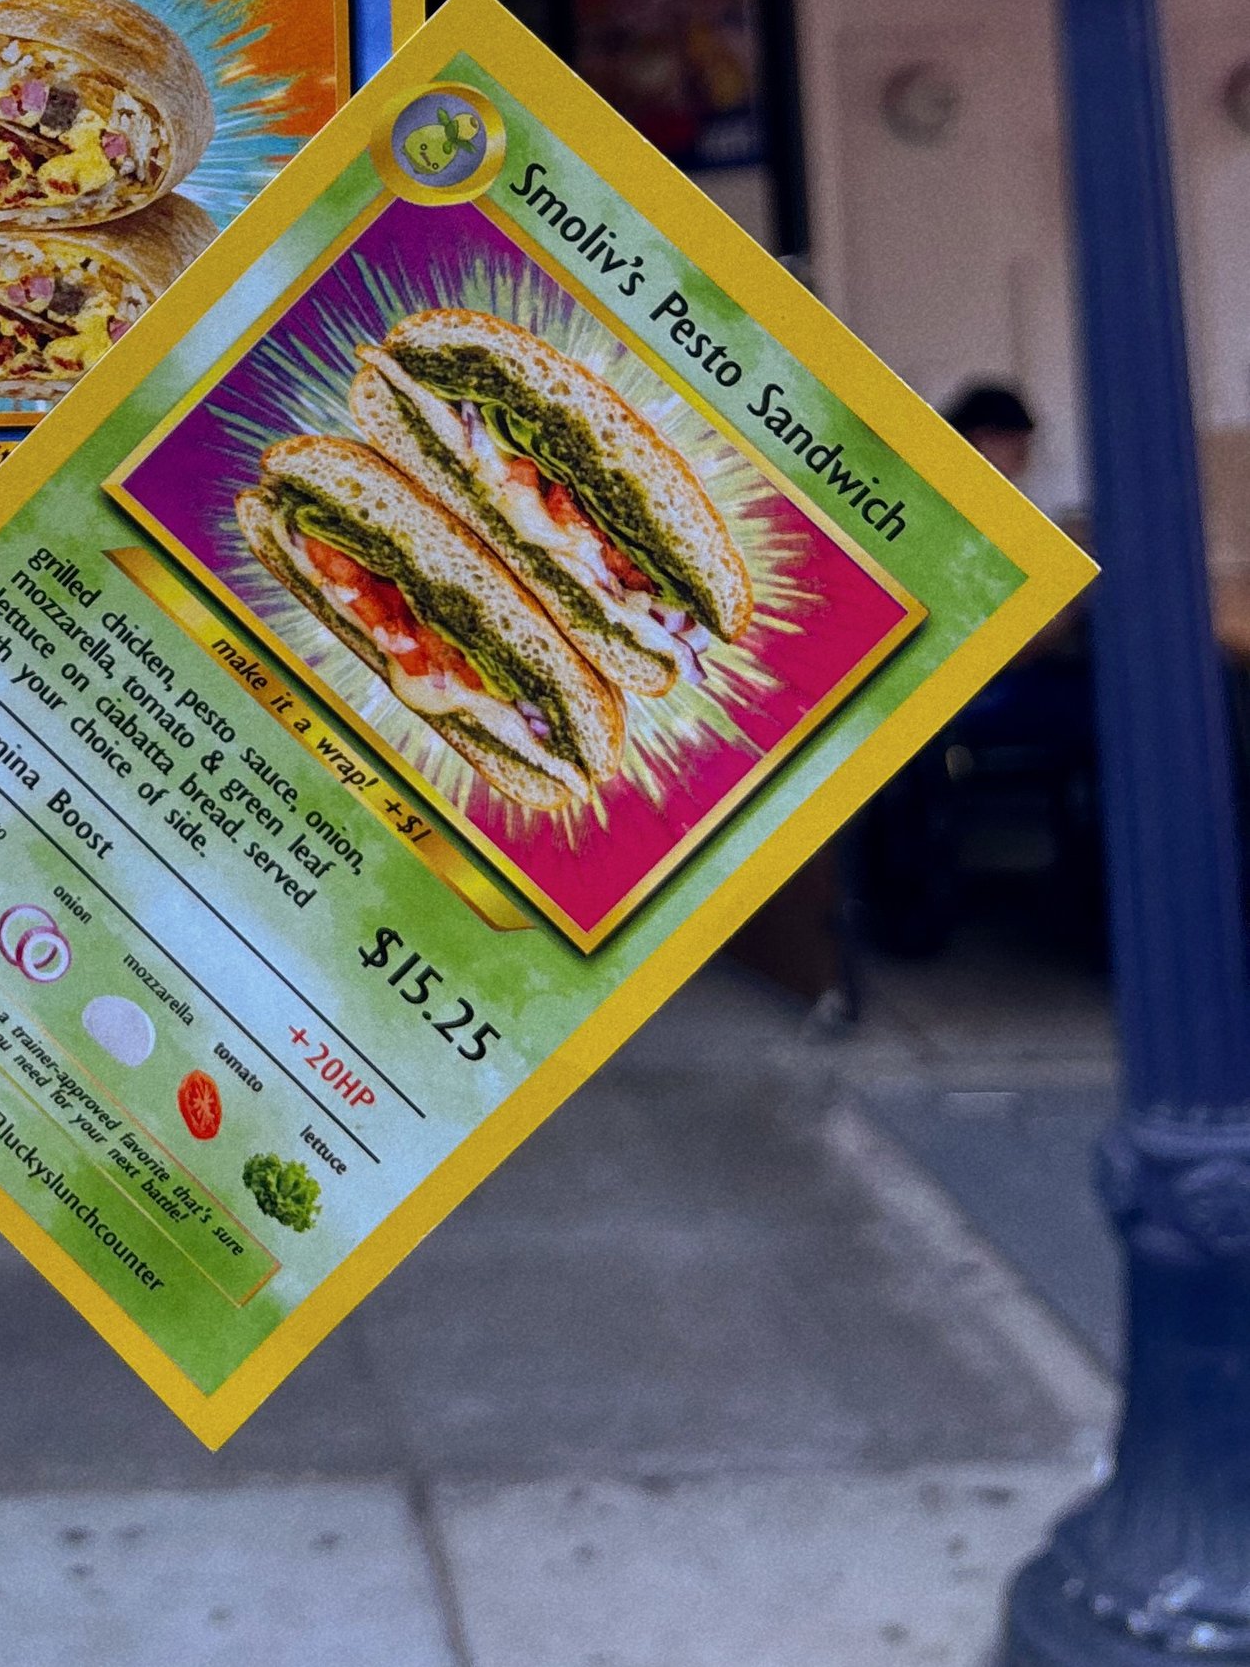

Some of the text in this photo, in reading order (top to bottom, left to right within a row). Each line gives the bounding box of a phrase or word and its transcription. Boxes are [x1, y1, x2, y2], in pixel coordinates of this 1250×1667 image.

[648, 289, 743, 388] Pesto
[746, 383, 906, 543] Sandwich
[9, 561, 337, 879] mozzarella, tomato & green leaf
[9, 662, 68, 711] your
[69, 716, 133, 779] choice
[137, 782, 170, 807] of
[163, 808, 207, 858] side.
[27, 547, 364, 876] grilled chicken, pesto sauce, onion,
[60, 662, 90, 693] on
[95, 695, 175, 777] ciabatta
[178, 771, 246, 844] bread.
[242, 841, 318, 909] served
[211, 638, 433, 844] make it a wrap! +$1
[45, 787, 114, 860] Boost
[52, 885, 93, 925] onion
[122, 952, 195, 1027] mozzarella
[213, 1041, 264, 1093] tomato
[288, 1025, 376, 1107] +20HP
[357, 926, 502, 1062] $15.25
[10, 1025, 123, 1132] trainer-approved
[118, 1131, 171, 1183] favorite
[211, 1226, 244, 1257] sure
[12, 1054, 53, 1088] need
[49, 1084, 74, 1110] for
[67, 1112, 108, 1144] your
[106, 1147, 142, 1180] next
[140, 1177, 190, 1224] battle!
[299, 1123, 347, 1176] lettuce
